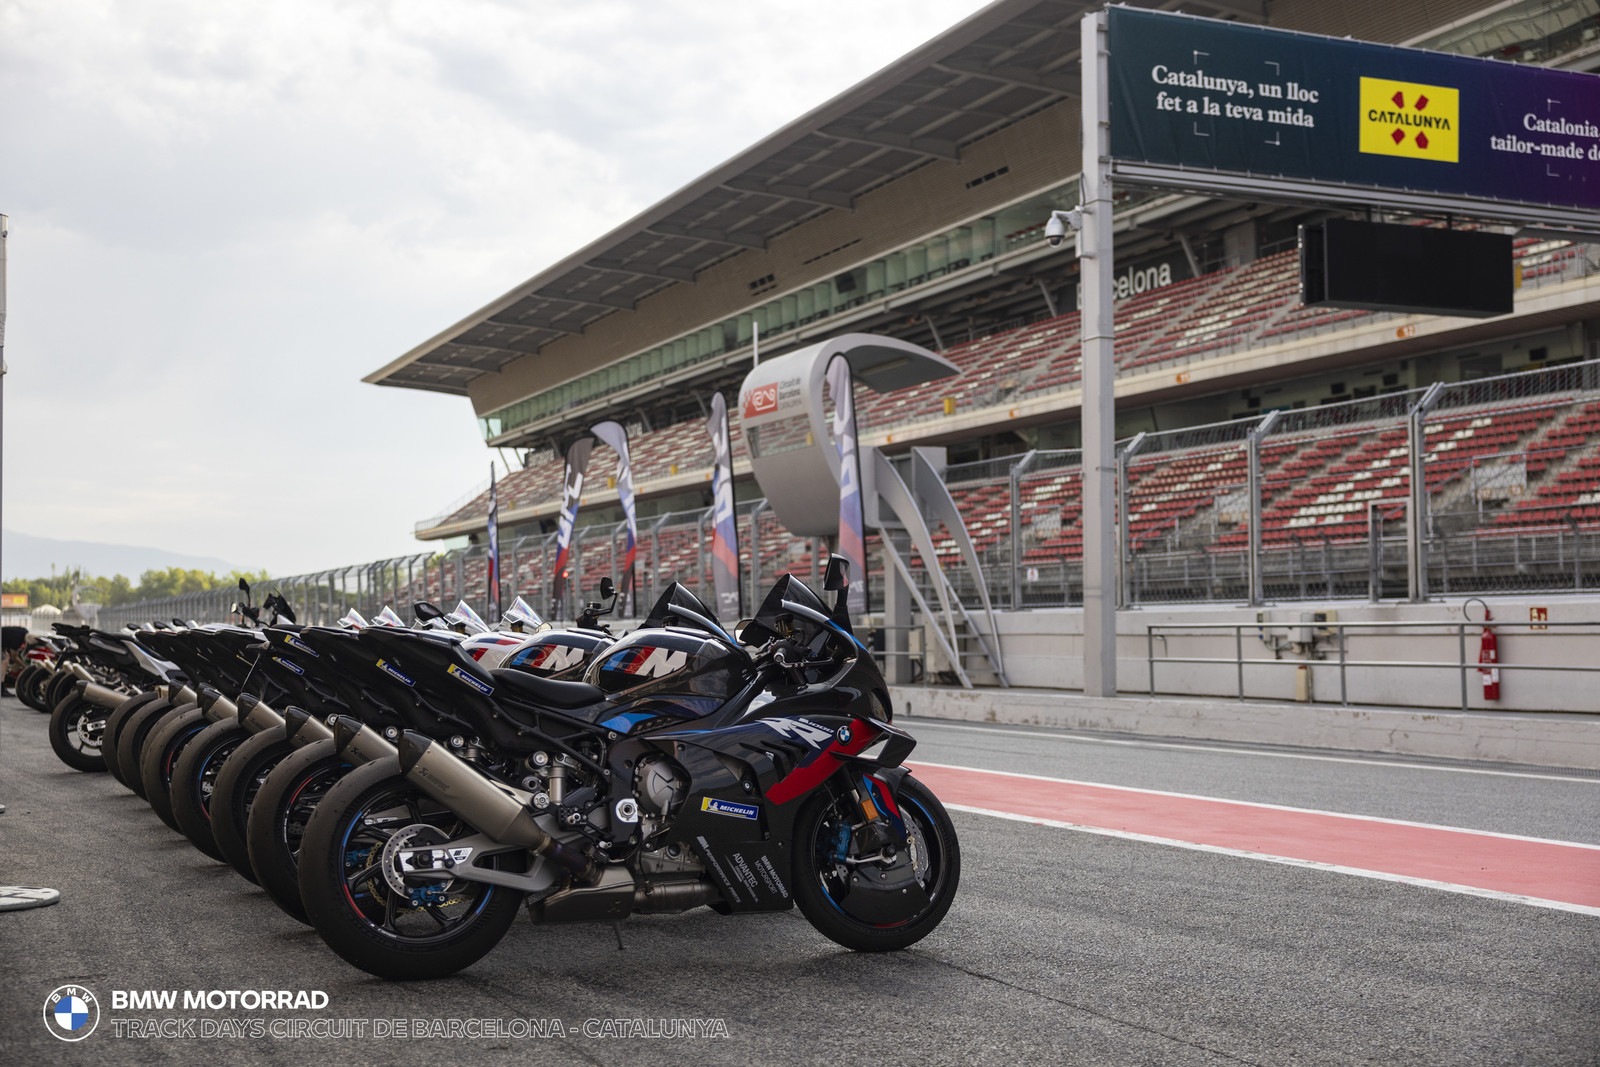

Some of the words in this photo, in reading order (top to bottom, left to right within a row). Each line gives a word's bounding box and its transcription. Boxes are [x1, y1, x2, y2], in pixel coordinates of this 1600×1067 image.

[1152, 65, 1254, 98] Catalunya,
[1258, 83, 1283, 98] un
[1286, 82, 1319, 103] lloc
[1156, 91, 1182, 111] fet
[1186, 99, 1198, 113] a
[1202, 96, 1221, 116] la
[1225, 102, 1263, 121] teva
[1267, 107, 1315, 128] mida
[1368, 109, 1451, 131] CATALUNYA
[1523, 112, 1600, 139] Catalonia
[1490, 134, 1584, 160] tailor-made
[387, 667, 412, 684] MICHELIN
[460, 673, 489, 692] MICHELIN
[719, 804, 755, 816] MICHELIN
[733, 852, 758, 888] ADVANTEC
[754, 860, 778, 895] MOTORSPORT
[760, 855, 773, 871] BMW
[768, 868, 789, 898] MOTORRAD
